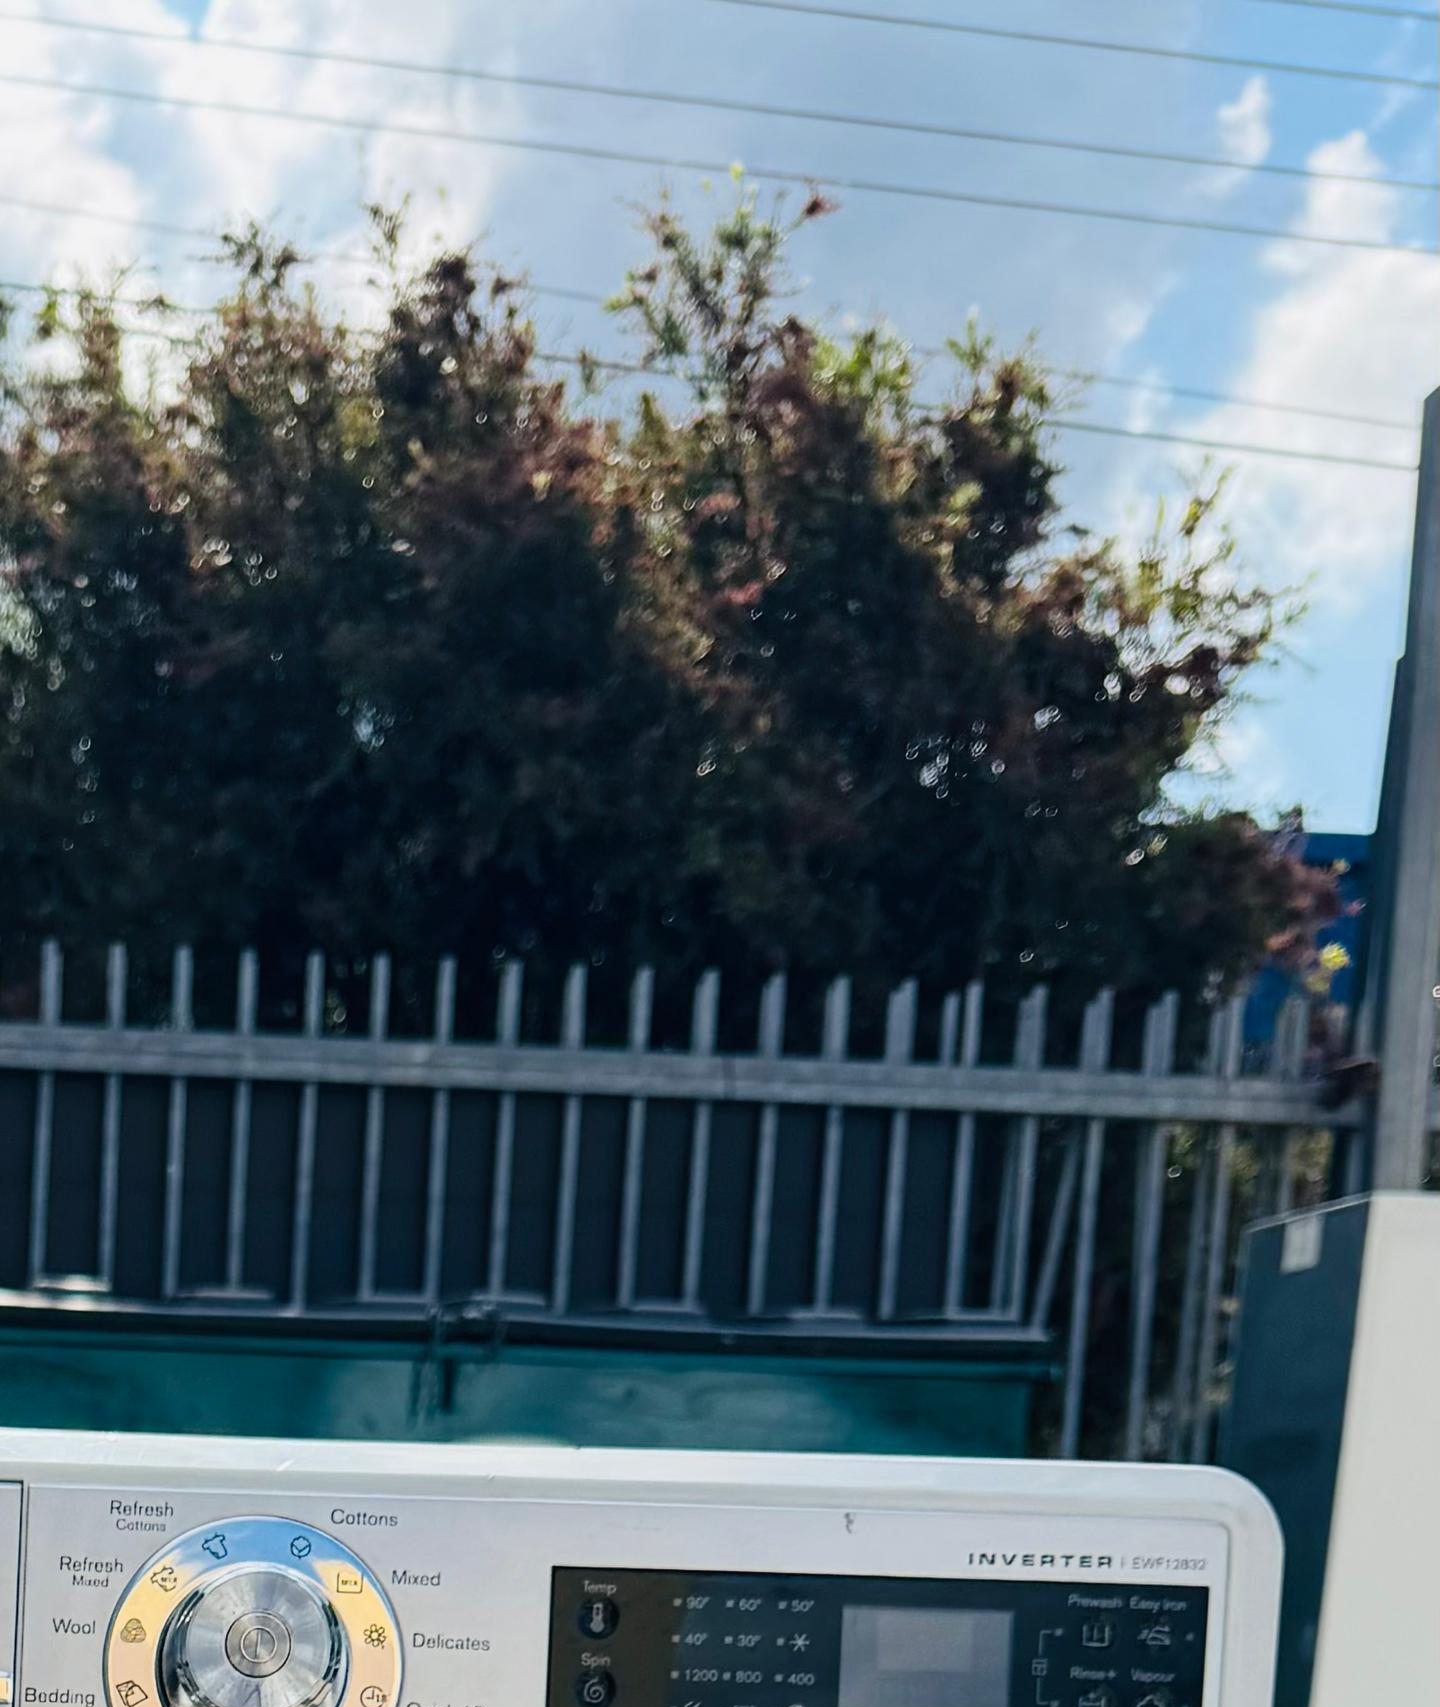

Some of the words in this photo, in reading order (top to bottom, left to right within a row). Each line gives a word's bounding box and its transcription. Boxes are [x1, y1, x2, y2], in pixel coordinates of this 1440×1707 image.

[109, 1500, 174, 1518] Refresh
[330, 1509, 399, 1528] Cottons
[59, 1556, 124, 1574] Refresh
[968, 1552, 1113, 1569] INVERTER
[392, 1570, 441, 1588] Mixed
[583, 1580, 617, 1595] Temp
[52, 1618, 96, 1636] Wool
[412, 1633, 491, 1652] Delicates
[580, 1653, 611, 1668] Spin
[684, 1669, 718, 1682] 1200
[735, 1671, 762, 1684] 800
[787, 1673, 815, 1686] 400
